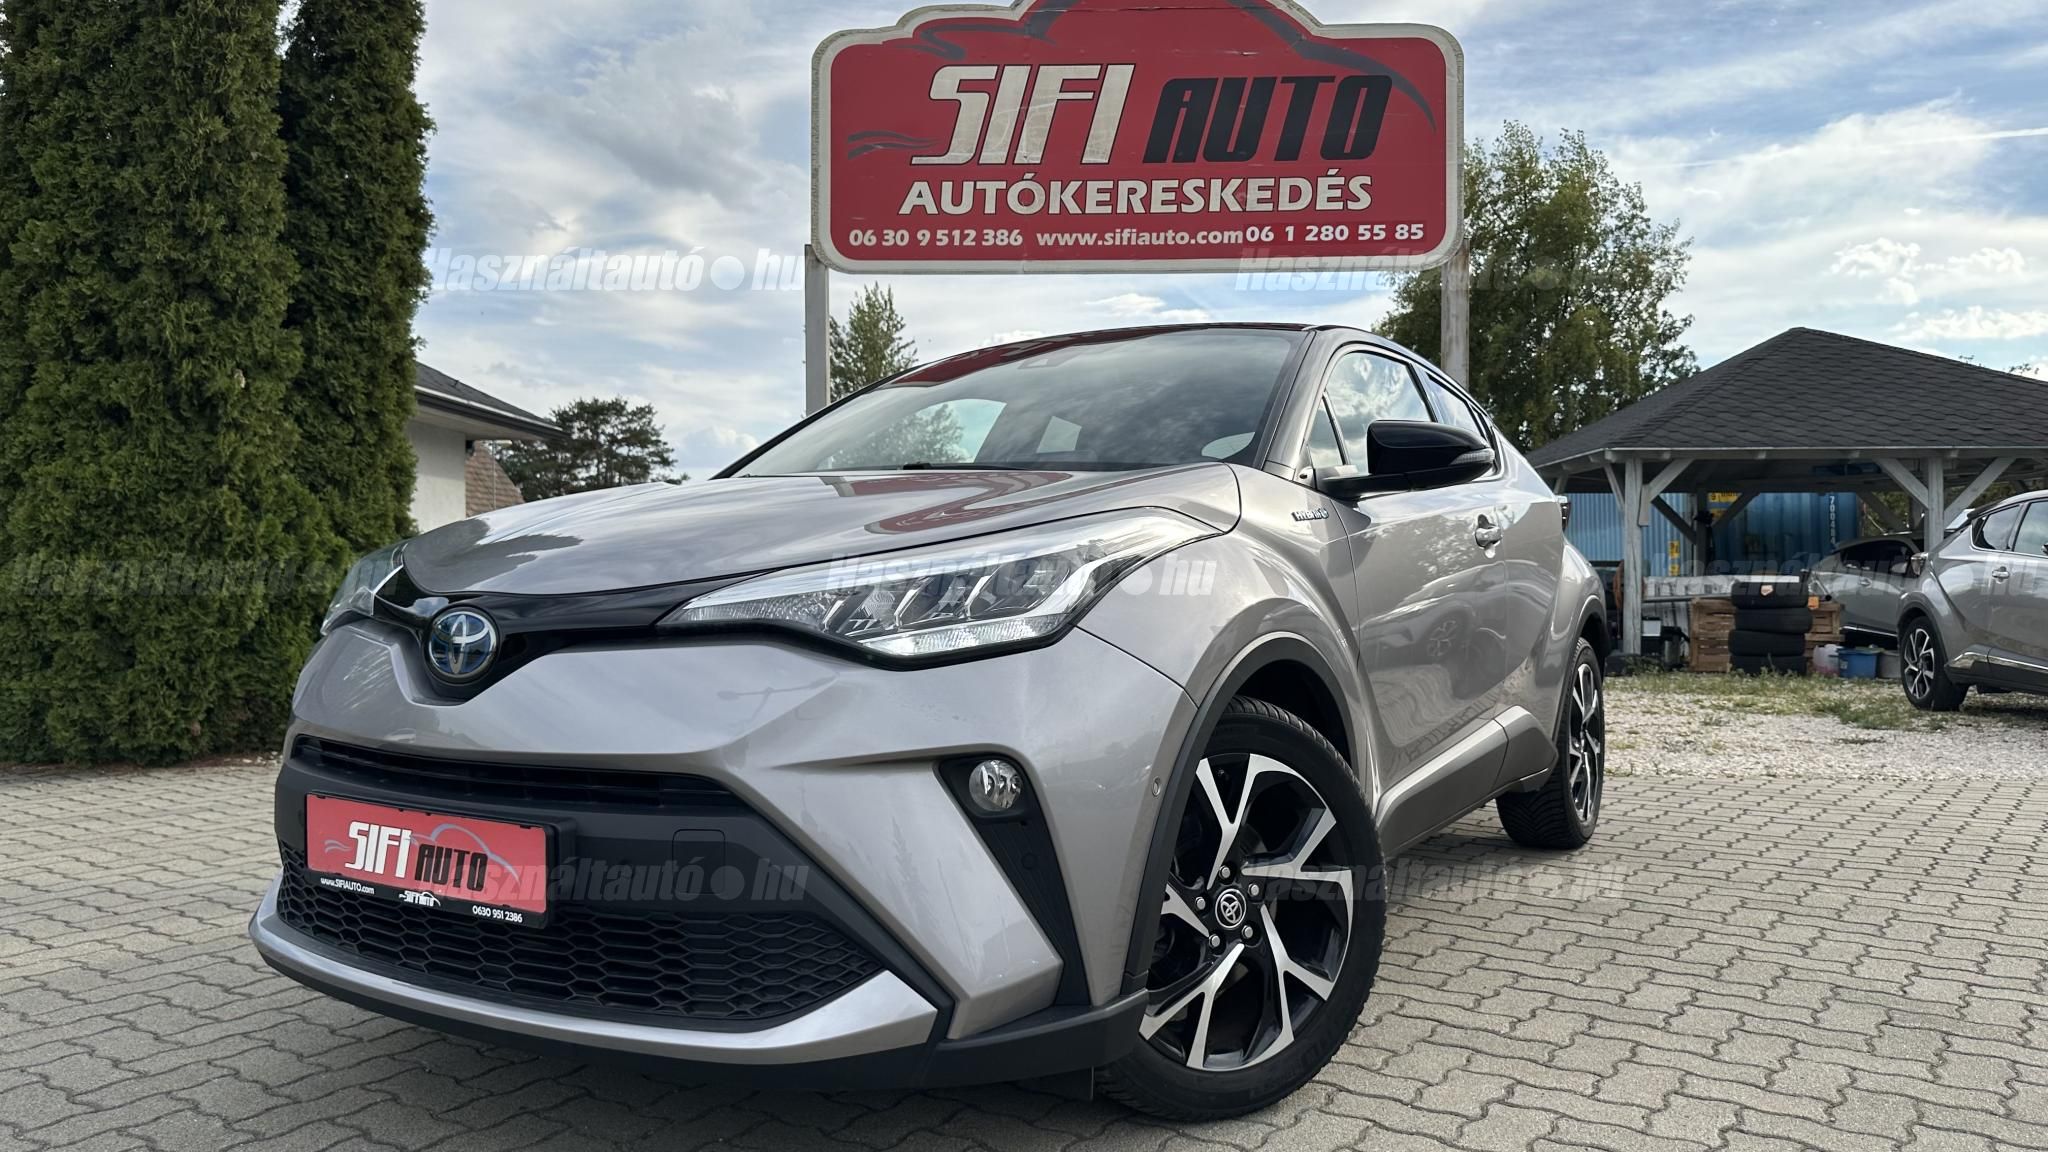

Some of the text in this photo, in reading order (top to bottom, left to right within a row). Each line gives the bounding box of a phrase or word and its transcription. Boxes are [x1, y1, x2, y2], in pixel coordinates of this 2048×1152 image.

[910, 63, 1394, 166] SIFI AUTO
[898, 169, 1373, 216] AUTÓKERESKEDÉS
[849, 223, 1425, 247] 06 30 9 512 386 www.sifiauto.com 06 1 280 55 85
[344, 821, 488, 892] SIFI AUTO
[472, 904, 523, 923] 0630 951 2386
